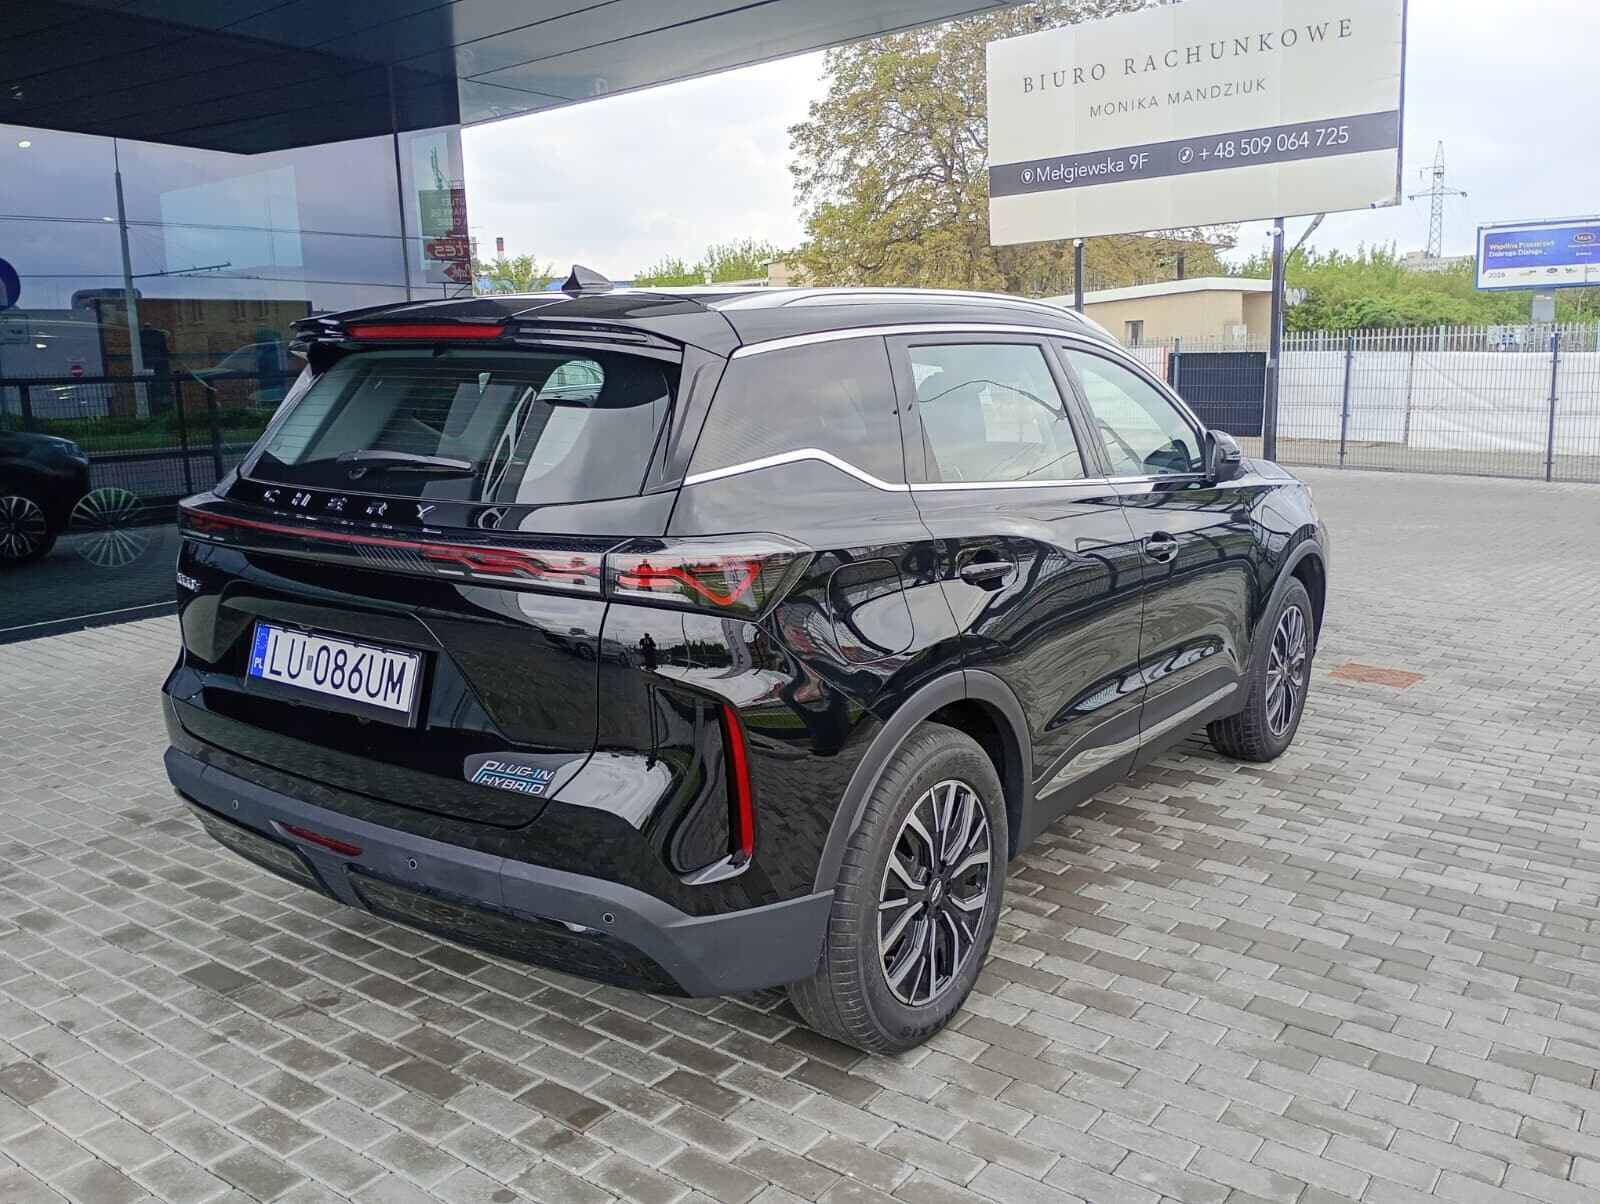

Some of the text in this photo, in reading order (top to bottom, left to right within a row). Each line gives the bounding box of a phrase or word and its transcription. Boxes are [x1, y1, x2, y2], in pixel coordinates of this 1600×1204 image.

[1023, 18, 1353, 94] BIURO RACHUNKOWE
[1089, 77, 1267, 118] MONIKA MANDZIUK
[1240, 136, 1272, 157] 509
[1276, 131, 1309, 152] 064
[1315, 126, 1349, 147] 725
[1036, 152, 1150, 184] Mełgiewska 9F
[263, 489, 436, 520] CHERY
[253, 657, 264, 670] PL
[269, 634, 406, 705] LU 086UM
[471, 760, 555, 782] PLUG-IN
[480, 775, 545, 794] HYBRID
